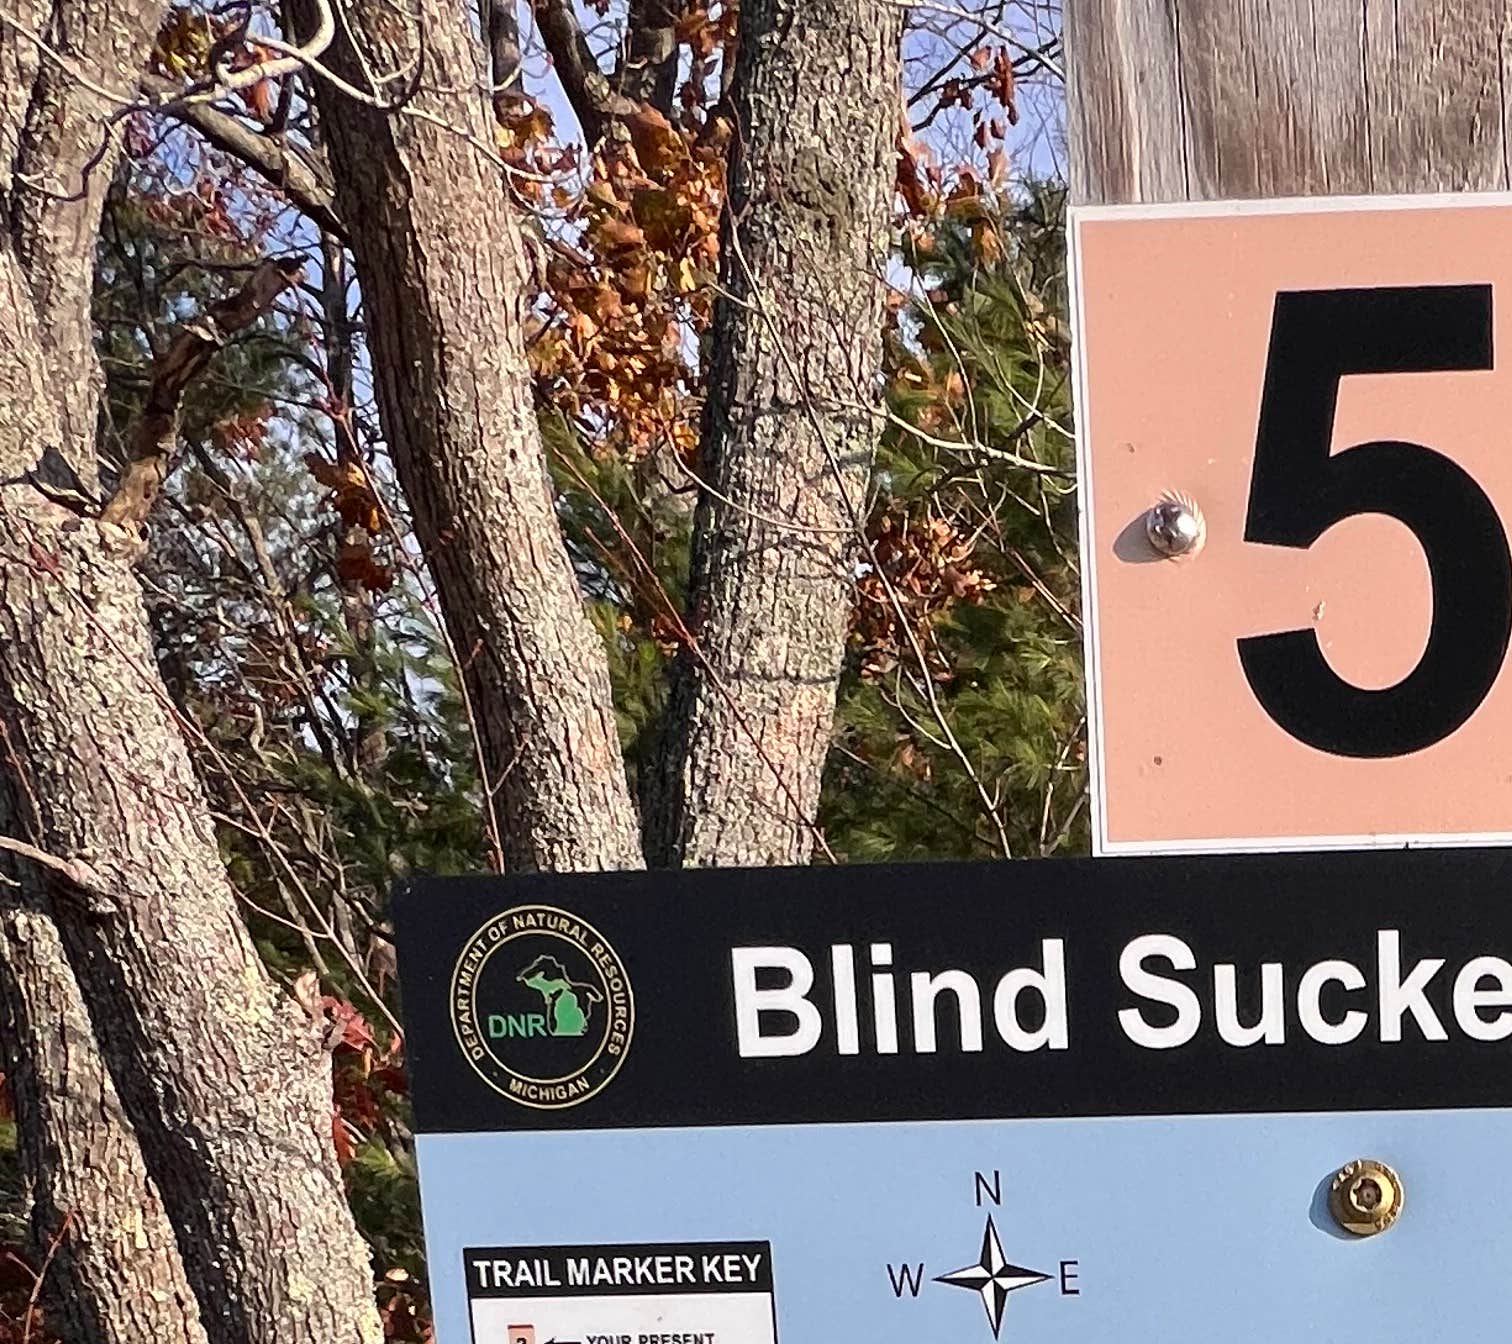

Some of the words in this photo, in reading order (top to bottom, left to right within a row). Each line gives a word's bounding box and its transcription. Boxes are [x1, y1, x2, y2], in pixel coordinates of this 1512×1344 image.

[457, 939, 488, 1061] DEPARTMENT
[488, 922, 510, 942] OF
[513, 913, 588, 945] NATURAL
[591, 942, 626, 1055] RESOURCES
[730, 938, 1070, 1058] Blind
[488, 1013, 547, 1038] DNR
[509, 1077, 590, 1100] MICHIGAN
[975, 1170, 1001, 1206] N
[473, 1259, 561, 1288] TRAIL
[567, 1256, 696, 1286] MARKER
[702, 1254, 762, 1283] KEY
[887, 1263, 924, 1297] W
[1060, 1261, 1080, 1295] E
